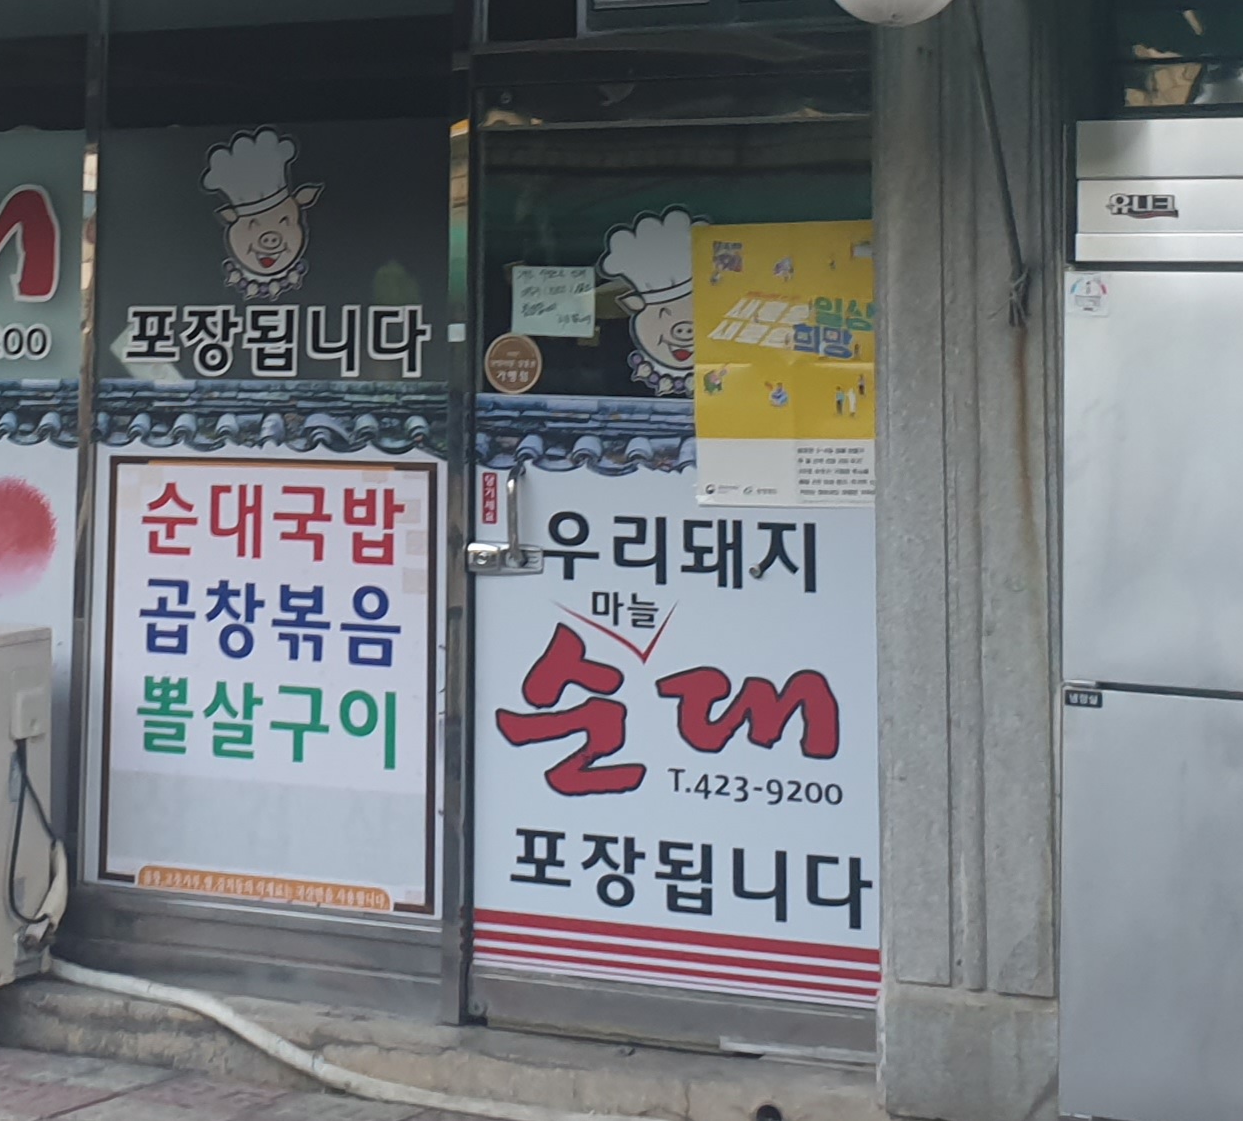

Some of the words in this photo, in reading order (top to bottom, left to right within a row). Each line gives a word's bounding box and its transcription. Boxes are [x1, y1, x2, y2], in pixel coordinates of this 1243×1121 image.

[123, 304, 433, 380] 포장됩니다
[141, 480, 406, 567] 순대국밥
[542, 510, 819, 594] 우리돼지
[138, 577, 403, 667] 곱창볶음
[592, 590, 660, 630] 마늘
[135, 675, 399, 770] 뽈살구이
[495, 622, 841, 797] 순대
[667, 768, 844, 806] T.423-9200
[509, 827, 874, 930] 포장됩니다
